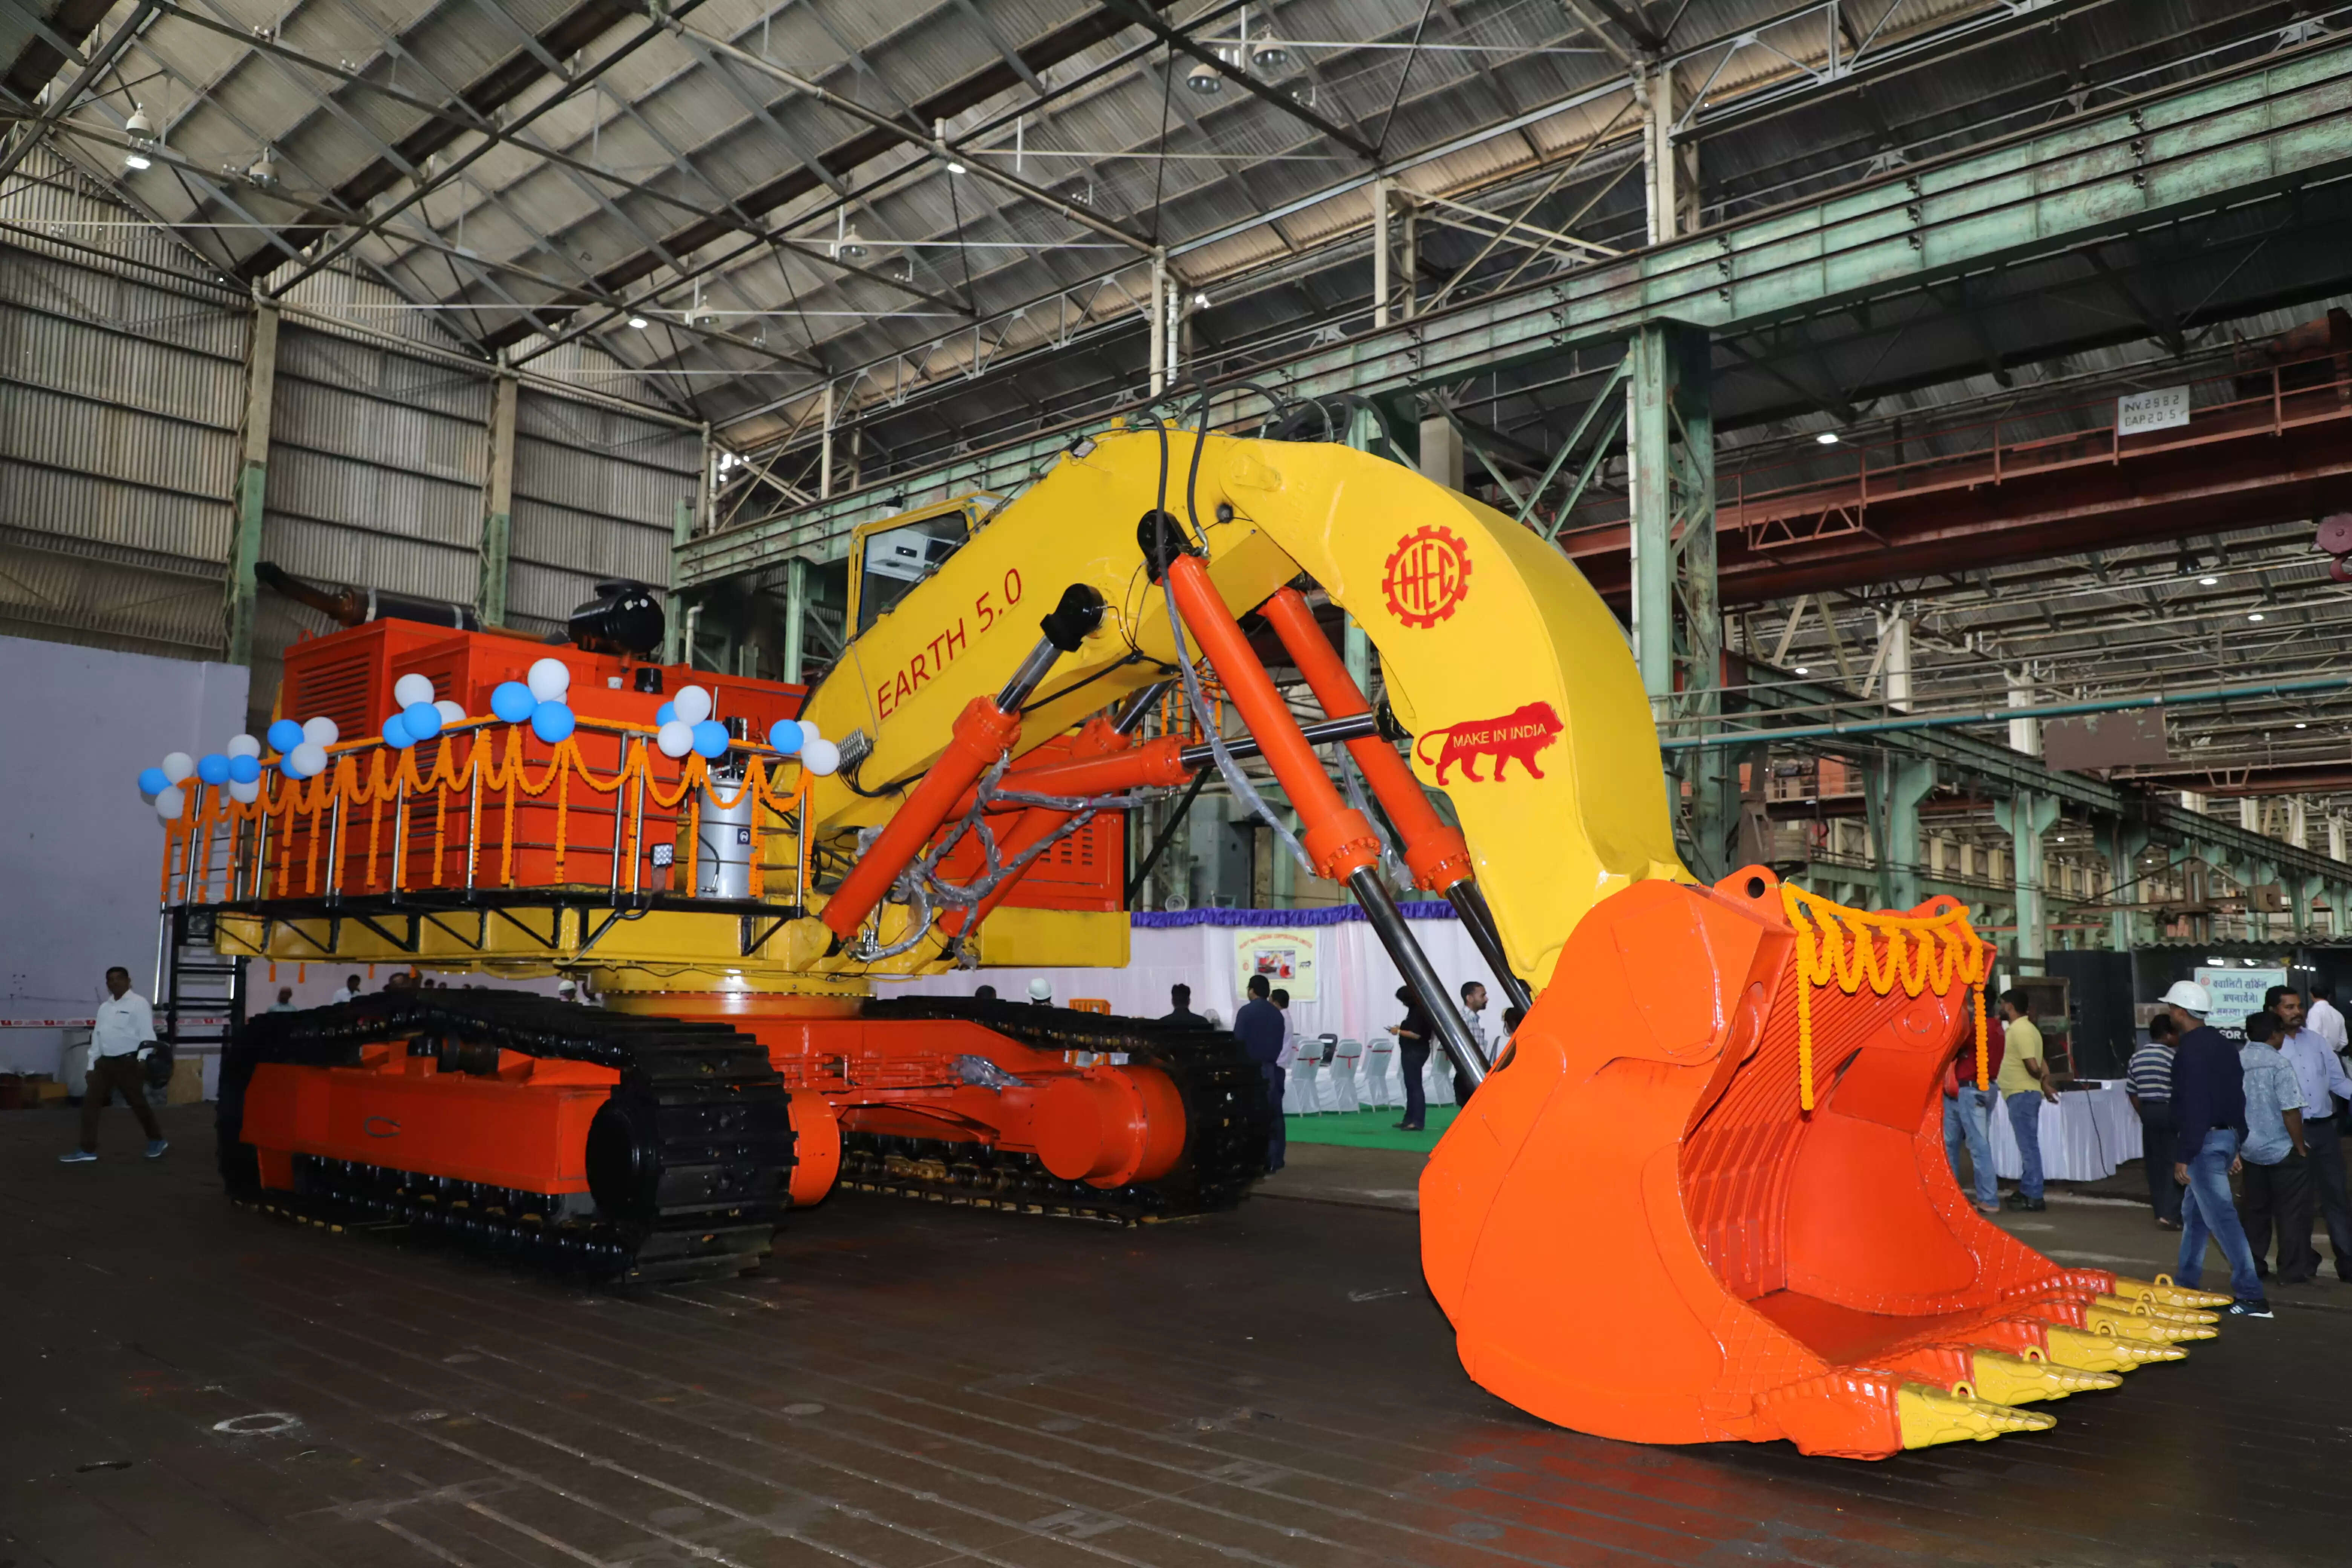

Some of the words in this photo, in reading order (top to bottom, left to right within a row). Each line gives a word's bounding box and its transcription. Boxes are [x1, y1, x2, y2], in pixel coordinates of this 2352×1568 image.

[1401, 543, 1455, 610] HEC
[877, 617, 966, 720] EARTH
[975, 568, 1022, 633] 5.0
[1453, 731, 1490, 748] MAKE
[1493, 728, 1507, 742] IN
[1510, 723, 1547, 739] INDIA
